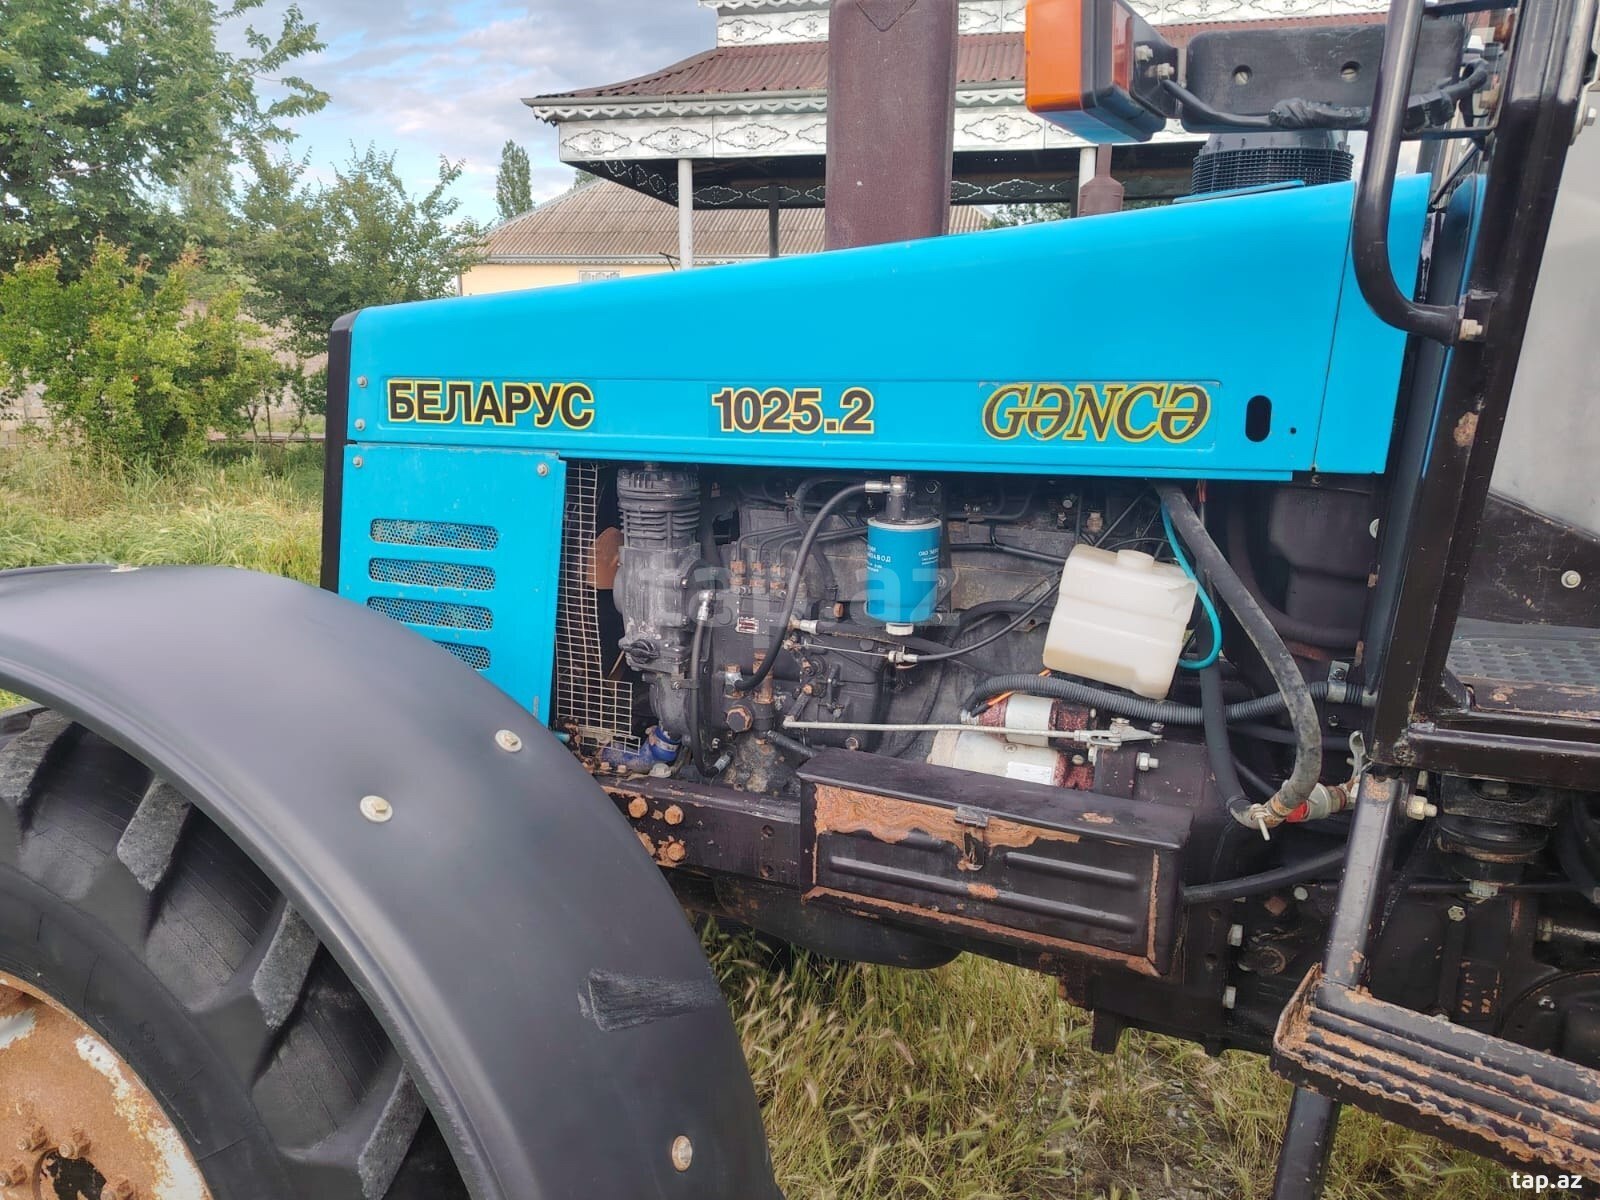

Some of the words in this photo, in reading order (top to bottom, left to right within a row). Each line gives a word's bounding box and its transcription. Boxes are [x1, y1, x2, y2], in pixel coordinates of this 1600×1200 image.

[387, 379, 595, 430] БЕЛАРУС
[711, 386, 875, 434] 1025.2
[981, 382, 1212, 442] GƏNCƏ
